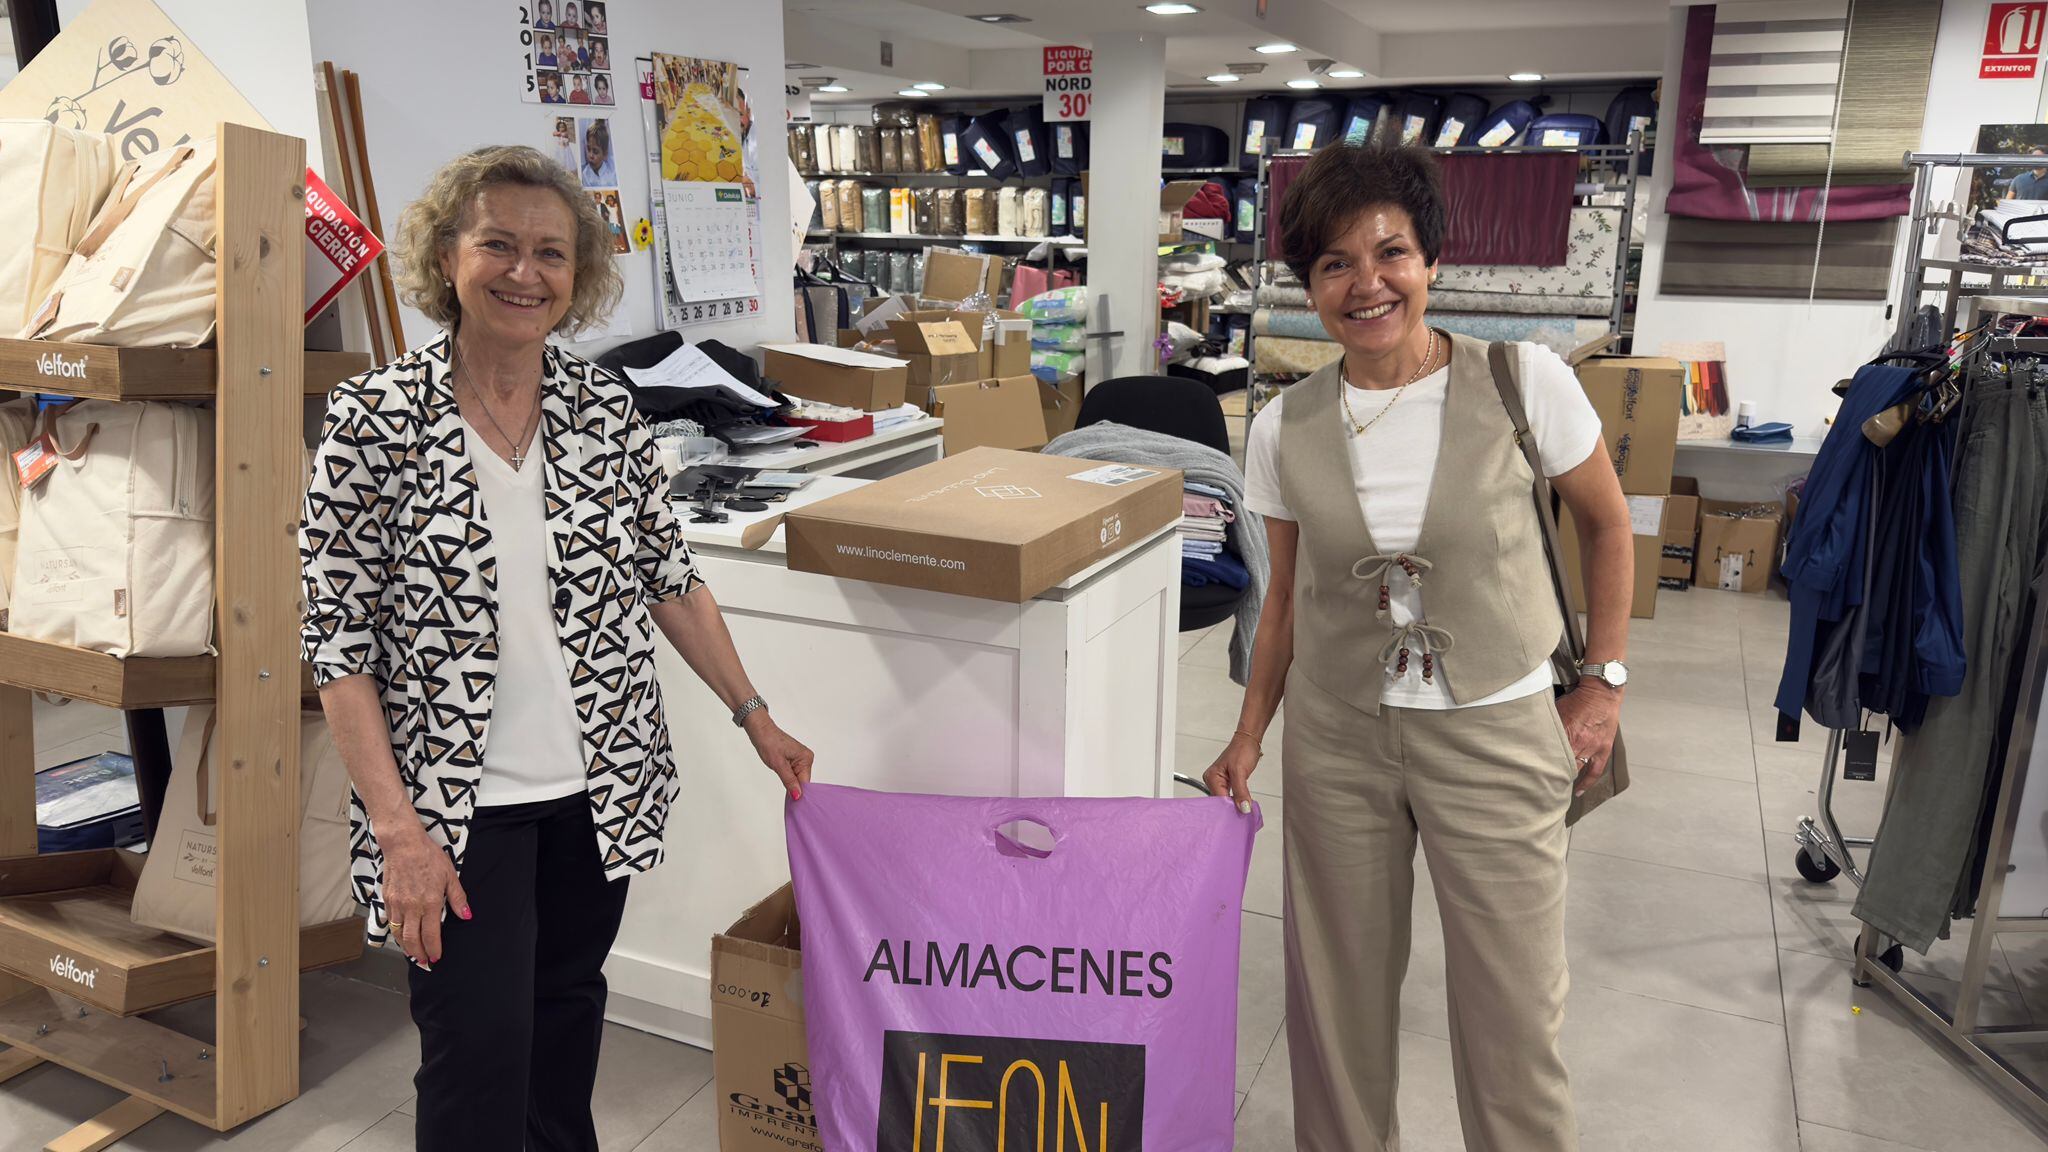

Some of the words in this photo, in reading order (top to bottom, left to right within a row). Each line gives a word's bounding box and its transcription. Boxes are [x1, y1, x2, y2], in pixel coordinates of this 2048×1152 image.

[1047, 61, 1076, 73] POR
[1984, 65, 2032, 73] EXTINTOR
[1045, 75, 1092, 92] NÓRD
[308, 219, 359, 272] CIERRE
[680, 307, 689, 321] 25
[694, 305, 703, 319] 26
[708, 303, 717, 317] 27
[722, 301, 732, 315] 28
[735, 300, 744, 313] 29
[749, 299, 759, 312] 30
[36, 352, 87, 379] Velfont
[836, 544, 966, 571] www.linoclemente.com
[49, 954, 95, 989] Velfont
[862, 938, 1173, 999] ALMACENES
